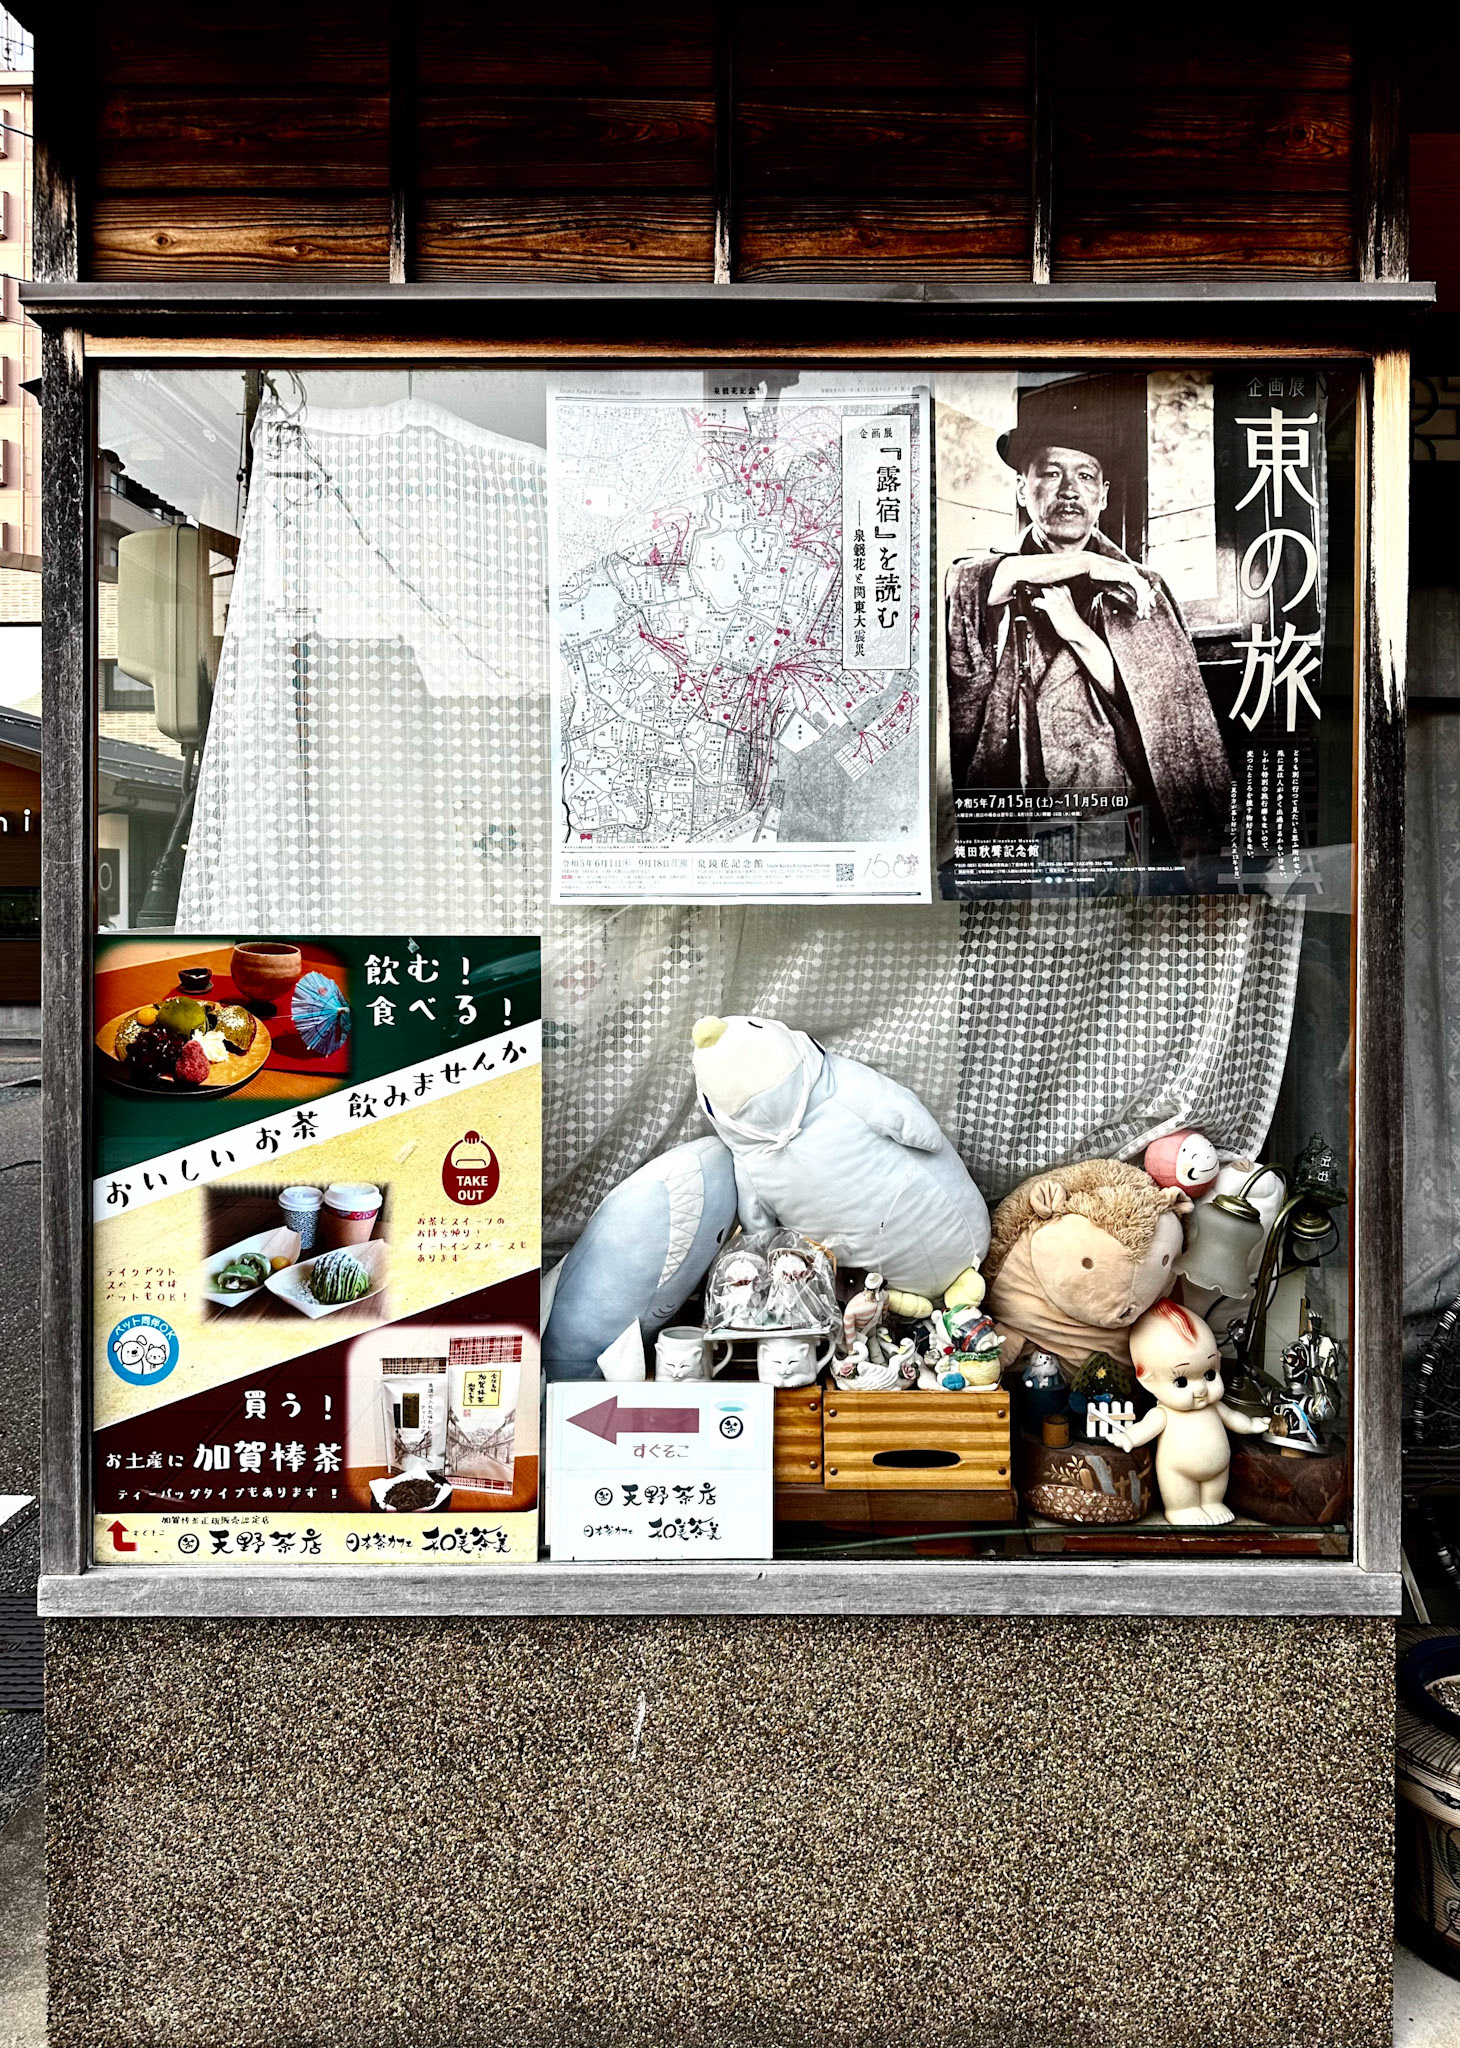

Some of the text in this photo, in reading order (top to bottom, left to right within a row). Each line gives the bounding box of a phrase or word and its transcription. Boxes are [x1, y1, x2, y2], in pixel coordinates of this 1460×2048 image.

[1247, 377, 1305, 397] 企画展
[859, 428, 893, 439] 企画展
[875, 447, 902, 629] 『露宿』を読む
[1229, 406, 1322, 732] 東の旅
[364, 953, 470, 985] 飲む！
[366, 995, 512, 1026] 食べる！
[456, 1175, 488, 1187] TAKE
[457, 1190, 484, 1200] OUT
[114, 1315, 177, 1341] ペット同伴OK
[244, 1390, 332, 1420] 買う！
[106, 1440, 343, 1474] お土産に 加賀棒茶
[633, 1443, 690, 1458] すぐそこ
[621, 1481, 717, 1507] 天野茶店
[209, 1527, 323, 1555] 天野茶店
